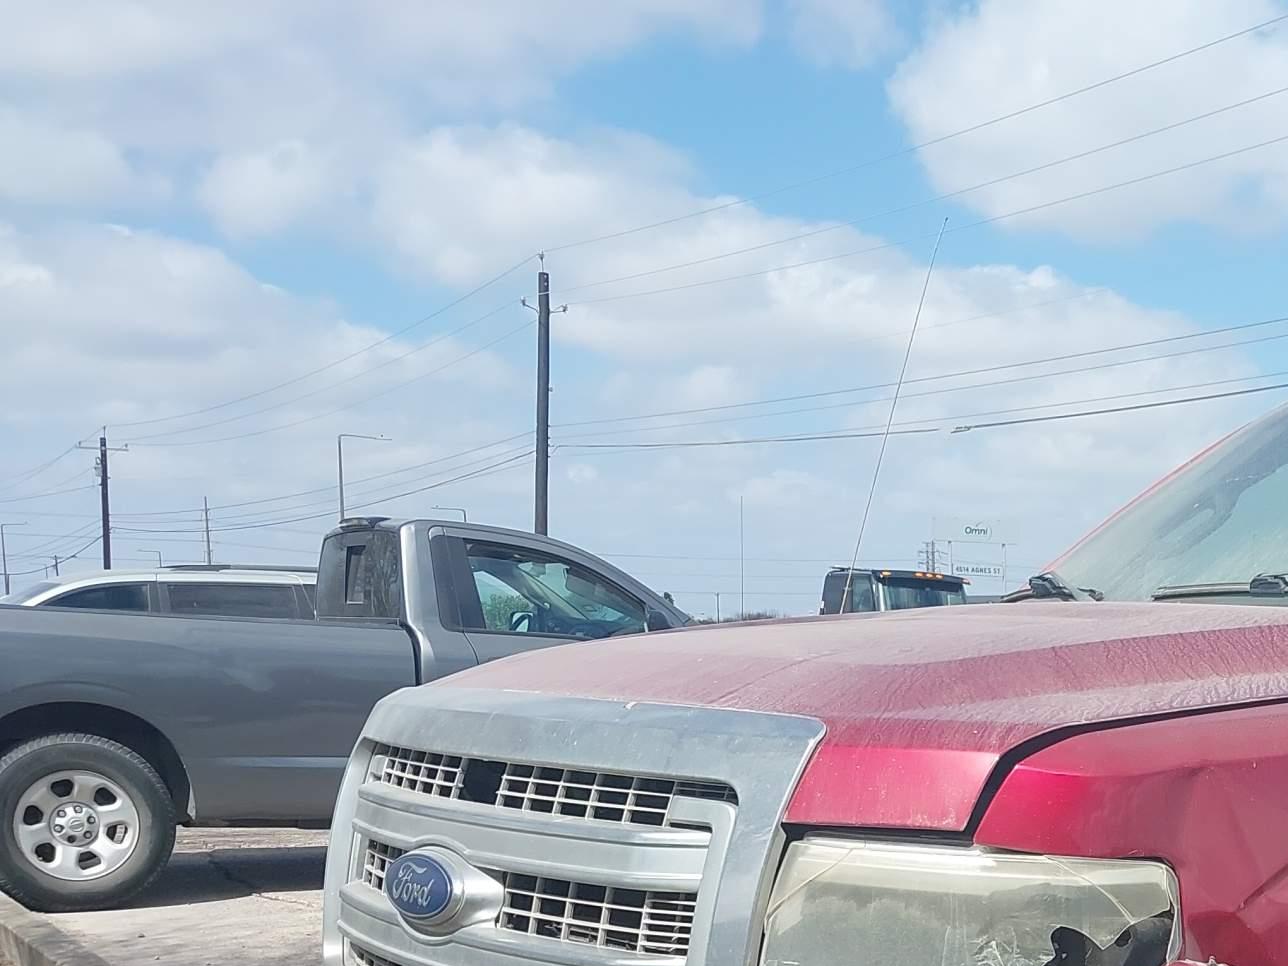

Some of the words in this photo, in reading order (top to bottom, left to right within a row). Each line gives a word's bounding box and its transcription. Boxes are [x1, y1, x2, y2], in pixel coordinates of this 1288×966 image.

[964, 526, 988, 535] Omni
[992, 567, 1001, 575] ST
[392, 861, 436, 908] Ford
